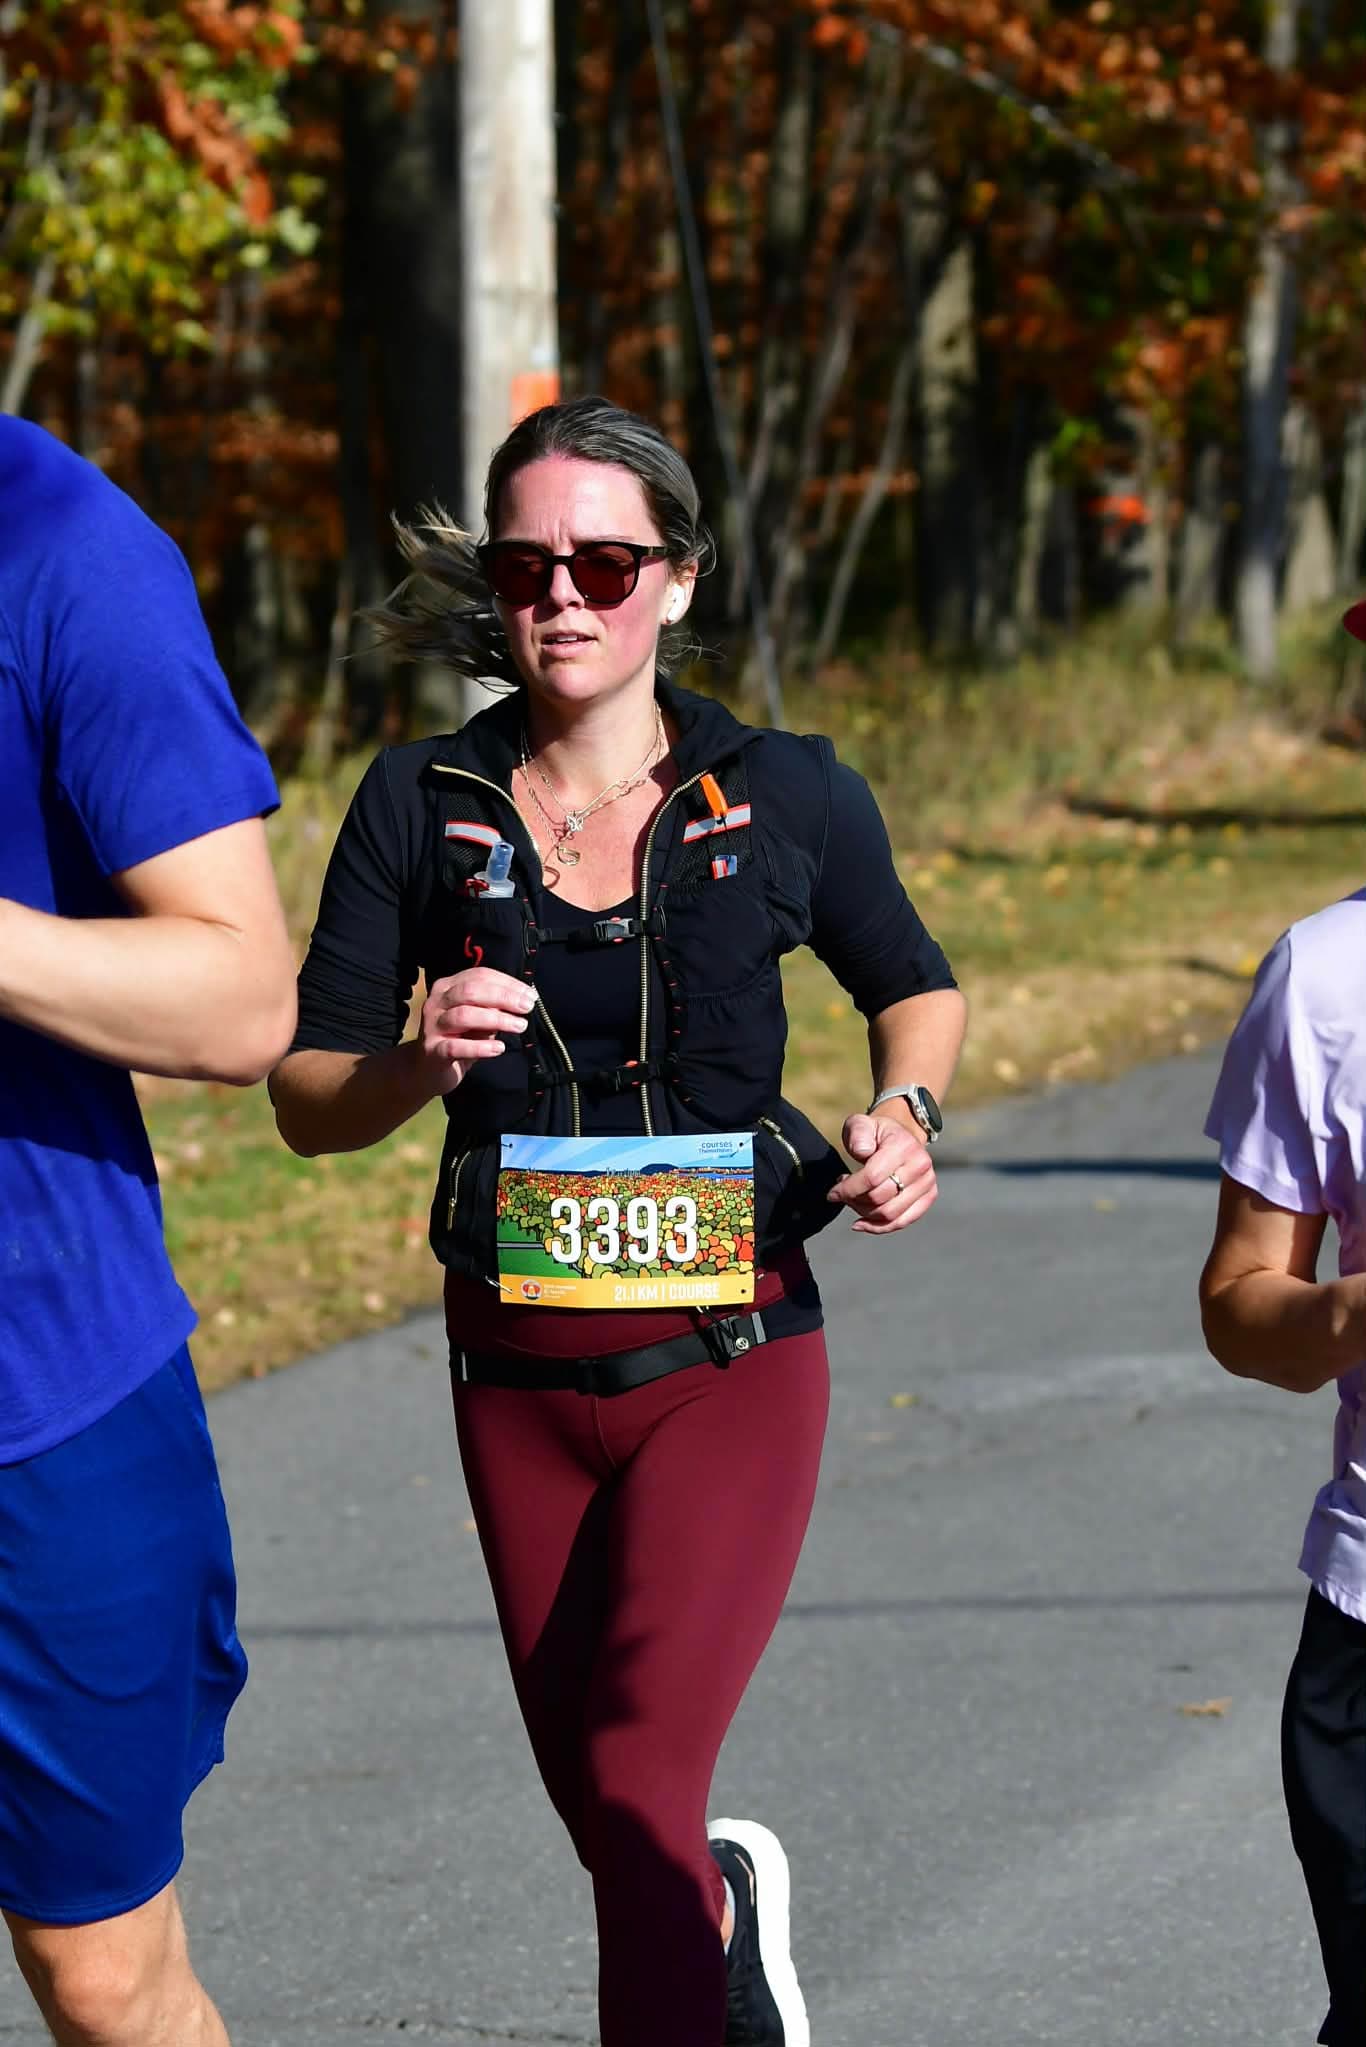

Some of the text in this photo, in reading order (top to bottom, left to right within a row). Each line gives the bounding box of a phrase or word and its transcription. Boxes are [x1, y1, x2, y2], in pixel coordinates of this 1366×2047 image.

[551, 1196, 698, 1264] 3393
[615, 1285, 635, 1302] 21.1
[638, 1284, 658, 1301] KM
[669, 1283, 720, 1299] COURSE
